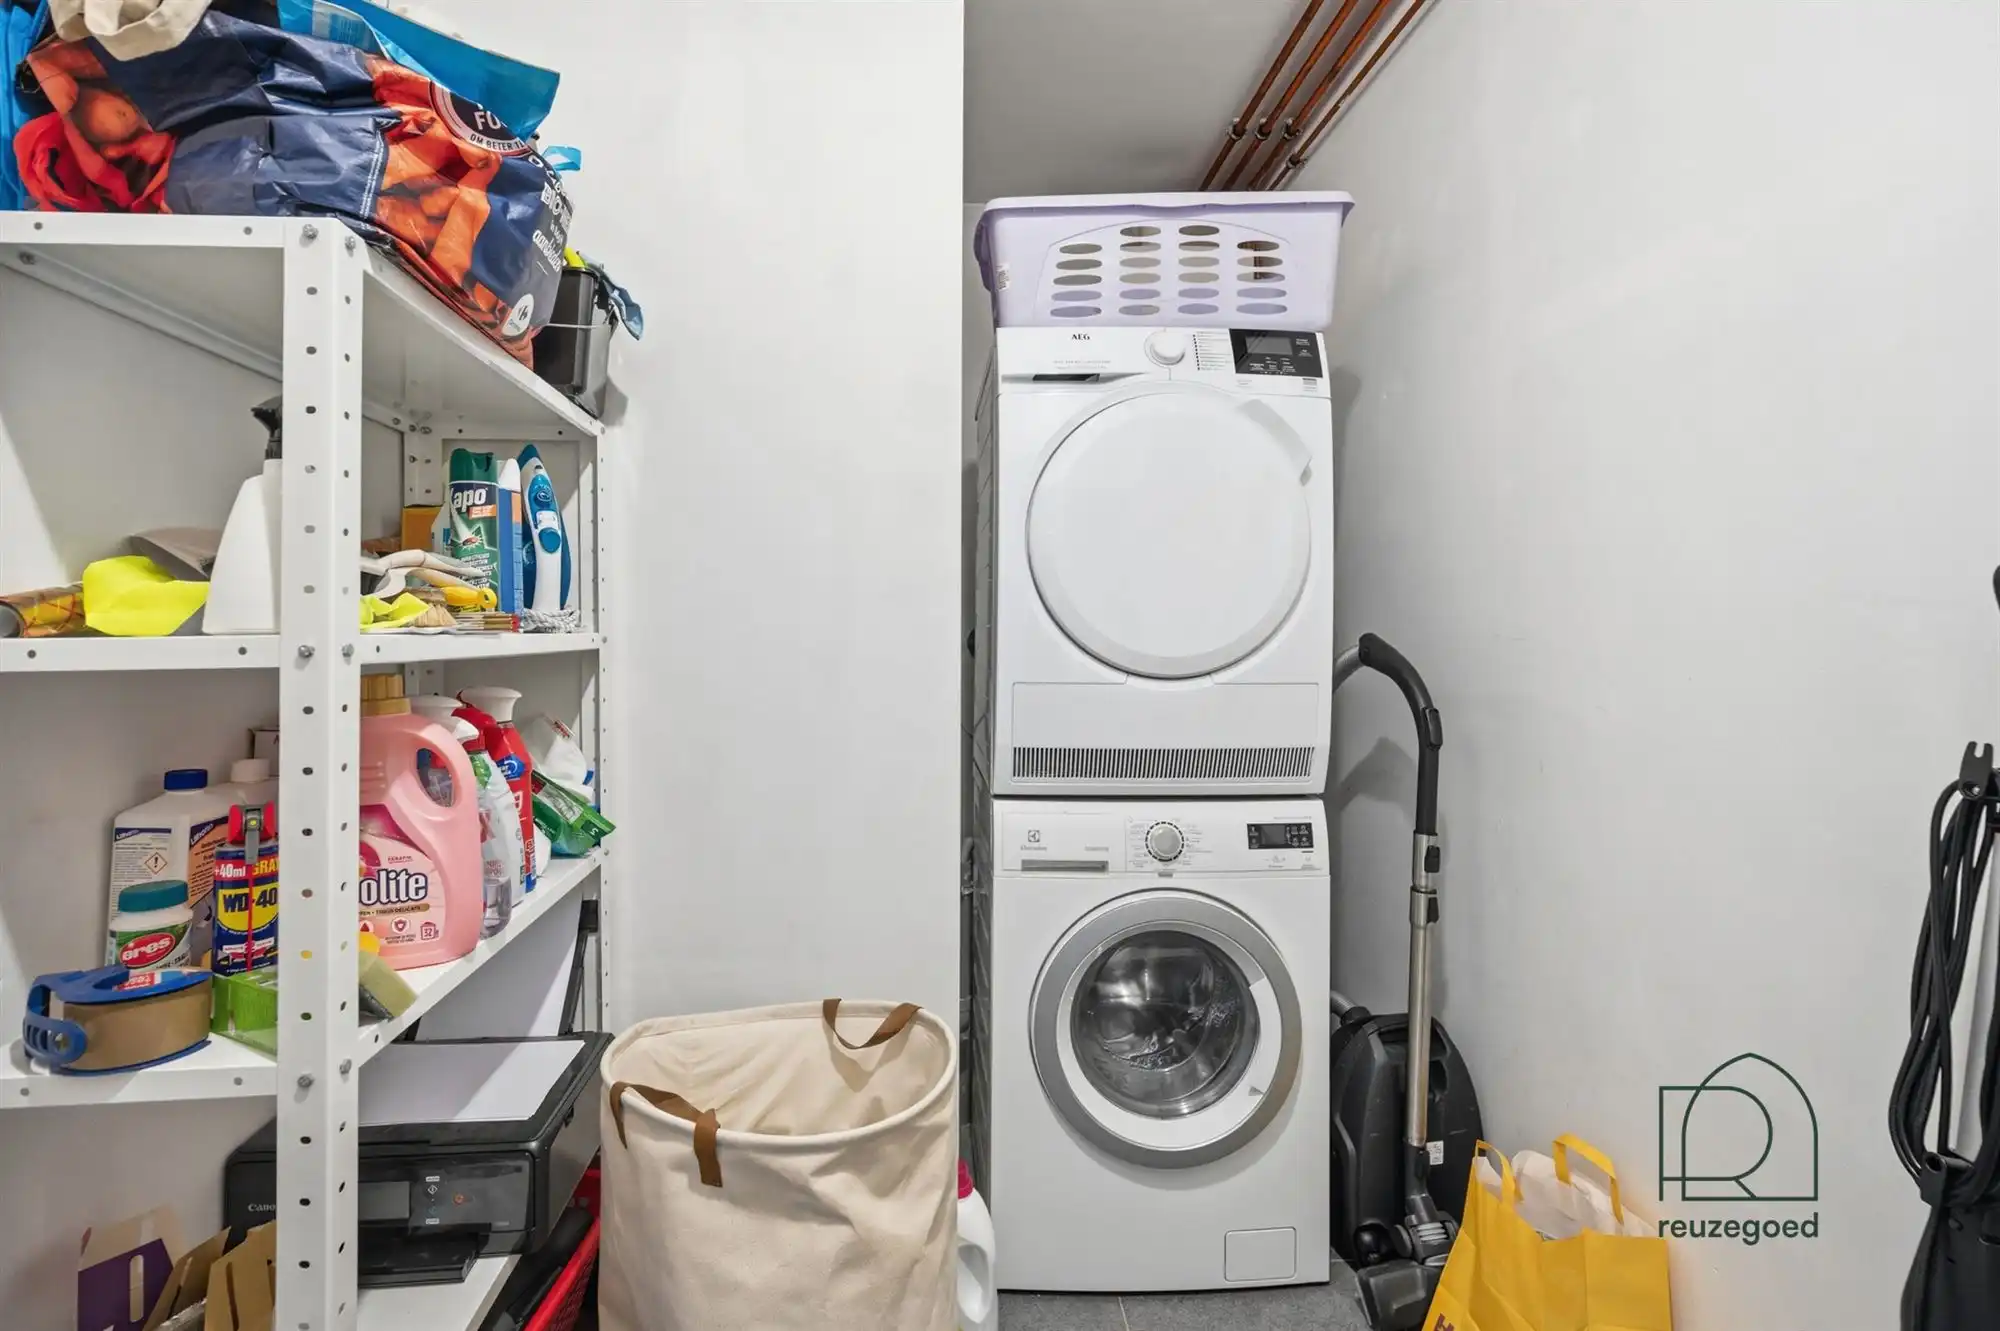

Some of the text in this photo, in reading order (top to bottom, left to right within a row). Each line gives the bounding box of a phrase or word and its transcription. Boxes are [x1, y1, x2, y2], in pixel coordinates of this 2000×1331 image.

[1072, 333, 1090, 341] AEG
[450, 487, 486, 513] apo
[214, 863, 246, 878] +40ml
[360, 868, 428, 907] olite
[223, 886, 278, 913] WD-40
[248, 1203, 276, 1213] Cano
